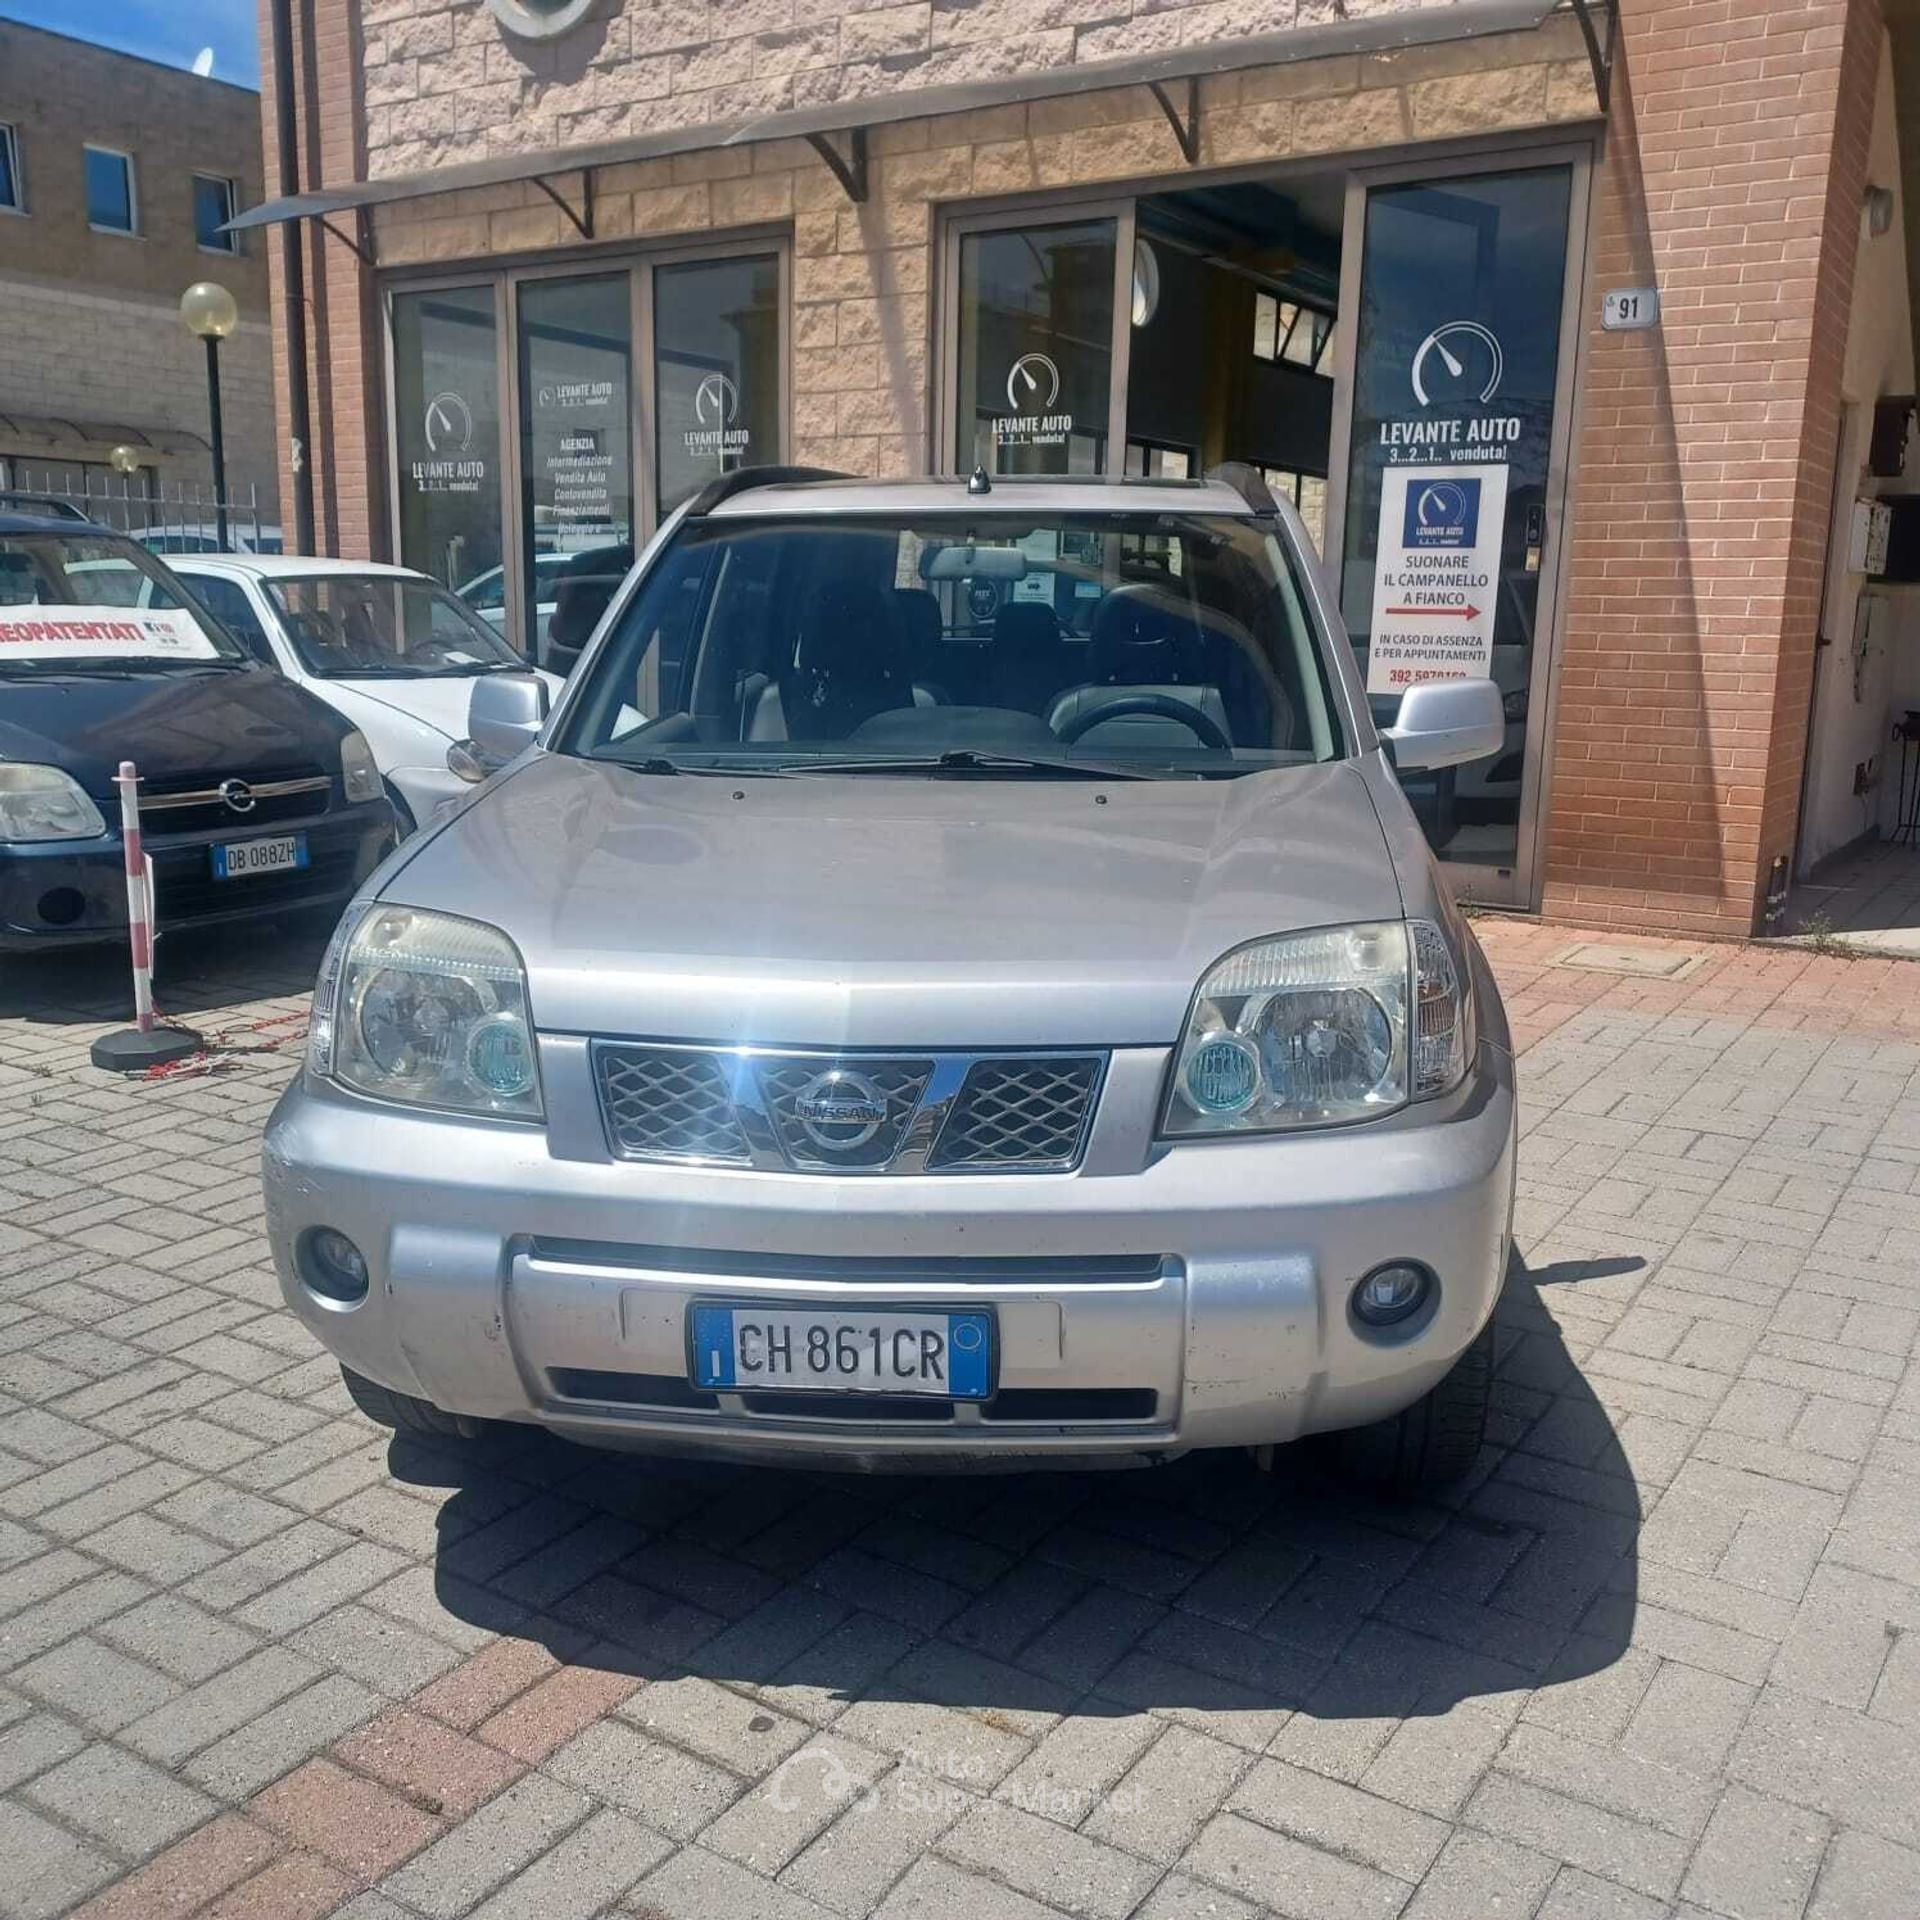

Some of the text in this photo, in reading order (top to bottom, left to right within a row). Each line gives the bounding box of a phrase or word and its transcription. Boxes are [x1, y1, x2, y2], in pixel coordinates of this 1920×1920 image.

[1619, 296, 1638, 320] 91
[556, 382, 612, 399] LEVANTE AUTO
[992, 415, 1072, 434] LEVANTE AUTO
[1380, 417, 1521, 445] LEVANTE AUTO
[560, 437, 595, 450] AGENZIA
[684, 429, 749, 446] LEVANTE AUTO
[1450, 444, 1508, 461] venduta!
[412, 460, 484, 479] LEVANTE AUTO
[1415, 526, 1445, 536] LEVANTE
[1405, 555, 1470, 569] SUONARE
[1384, 573, 1489, 588] IL CAMPANELLO
[1403, 591, 1466, 606] A FIANCO
[0, 621, 145, 642] EOPATENTATI
[1380, 634, 1483, 647] IN CASO DI ASSENZA
[1374, 648, 1487, 661] E PER APPUNTAMENTI
[1389, 669, 1412, 683] 392
[227, 842, 295, 871] DB 088ZH
[803, 1104, 886, 1119] NISSAN
[739, 1324, 946, 1381] CH 861CR
